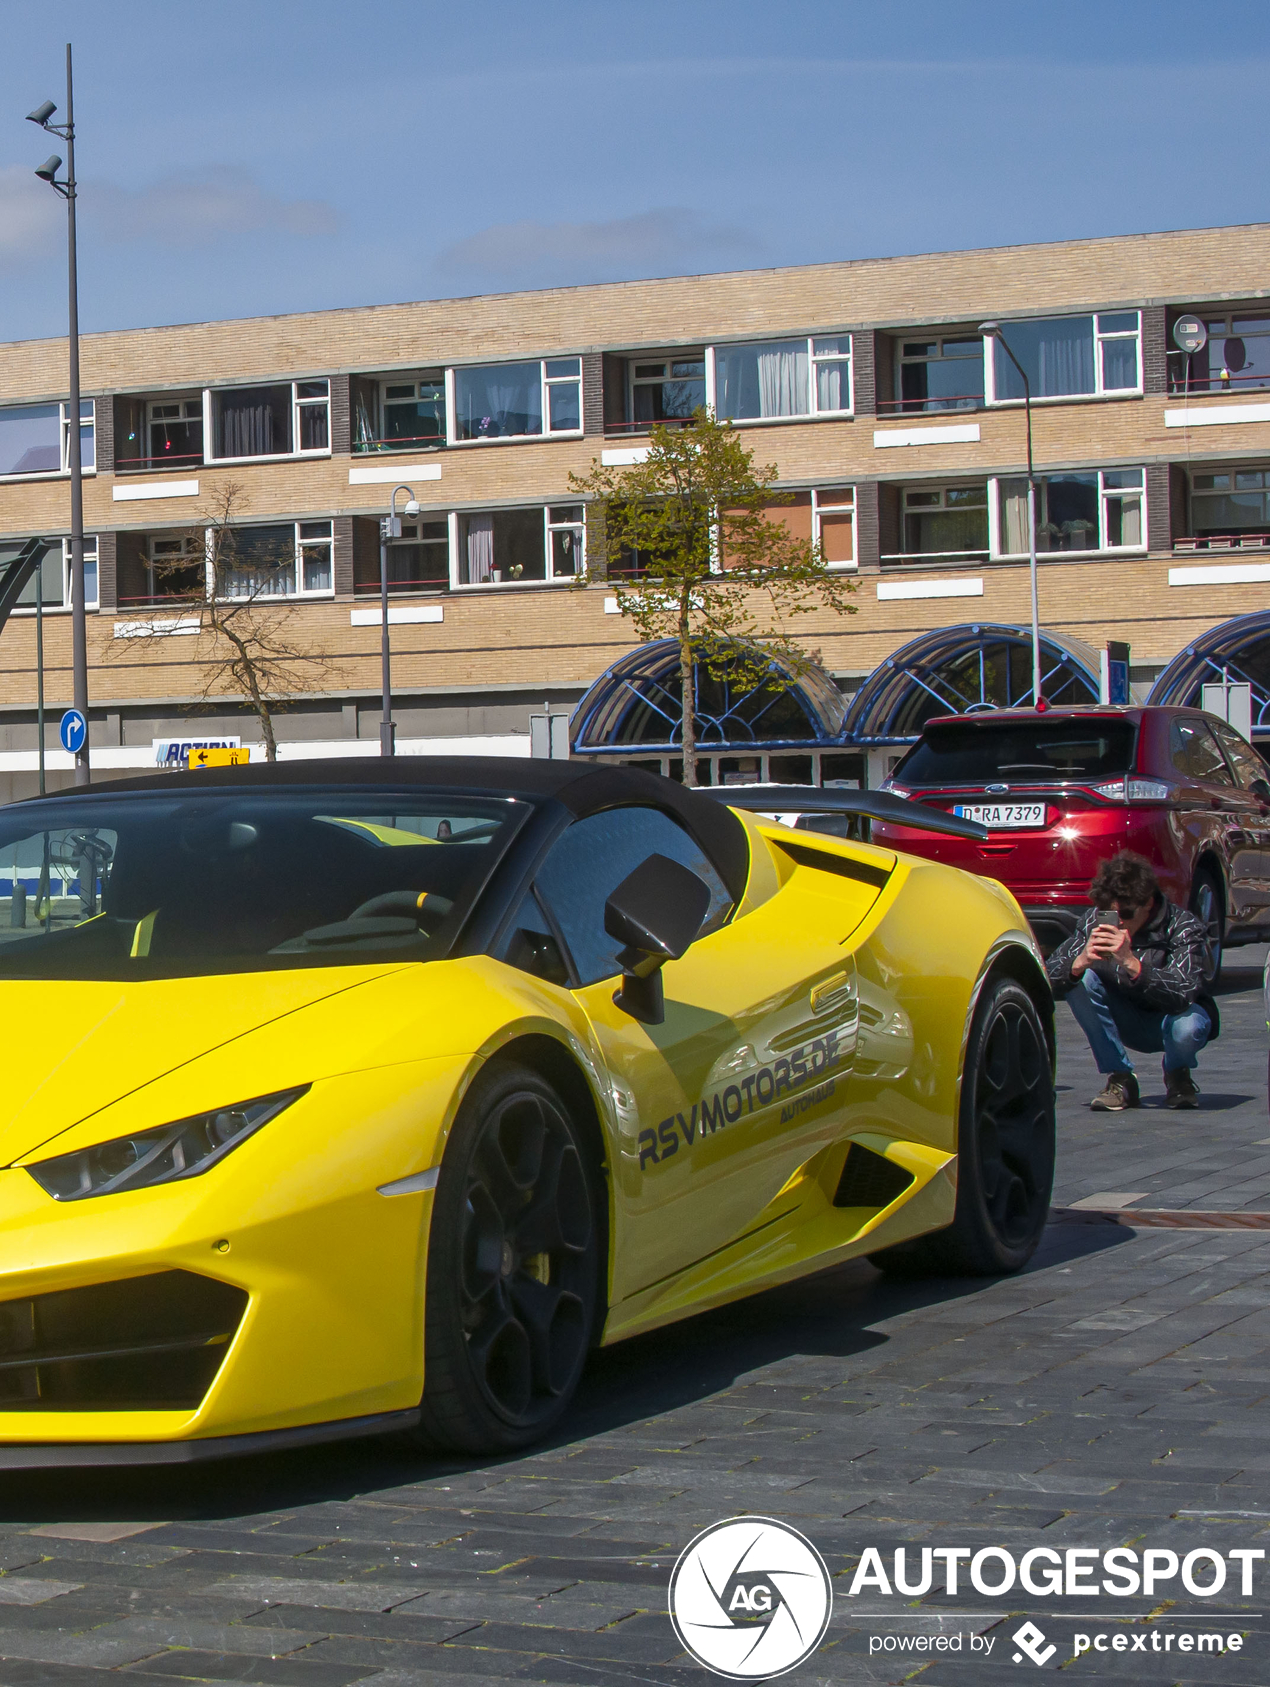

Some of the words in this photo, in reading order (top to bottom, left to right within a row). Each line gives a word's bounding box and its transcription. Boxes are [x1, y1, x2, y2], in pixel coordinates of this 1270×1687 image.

[982, 807, 1001, 821] RA
[1005, 806, 1042, 821] 7379
[780, 1079, 836, 1125] AUTOHAUS
